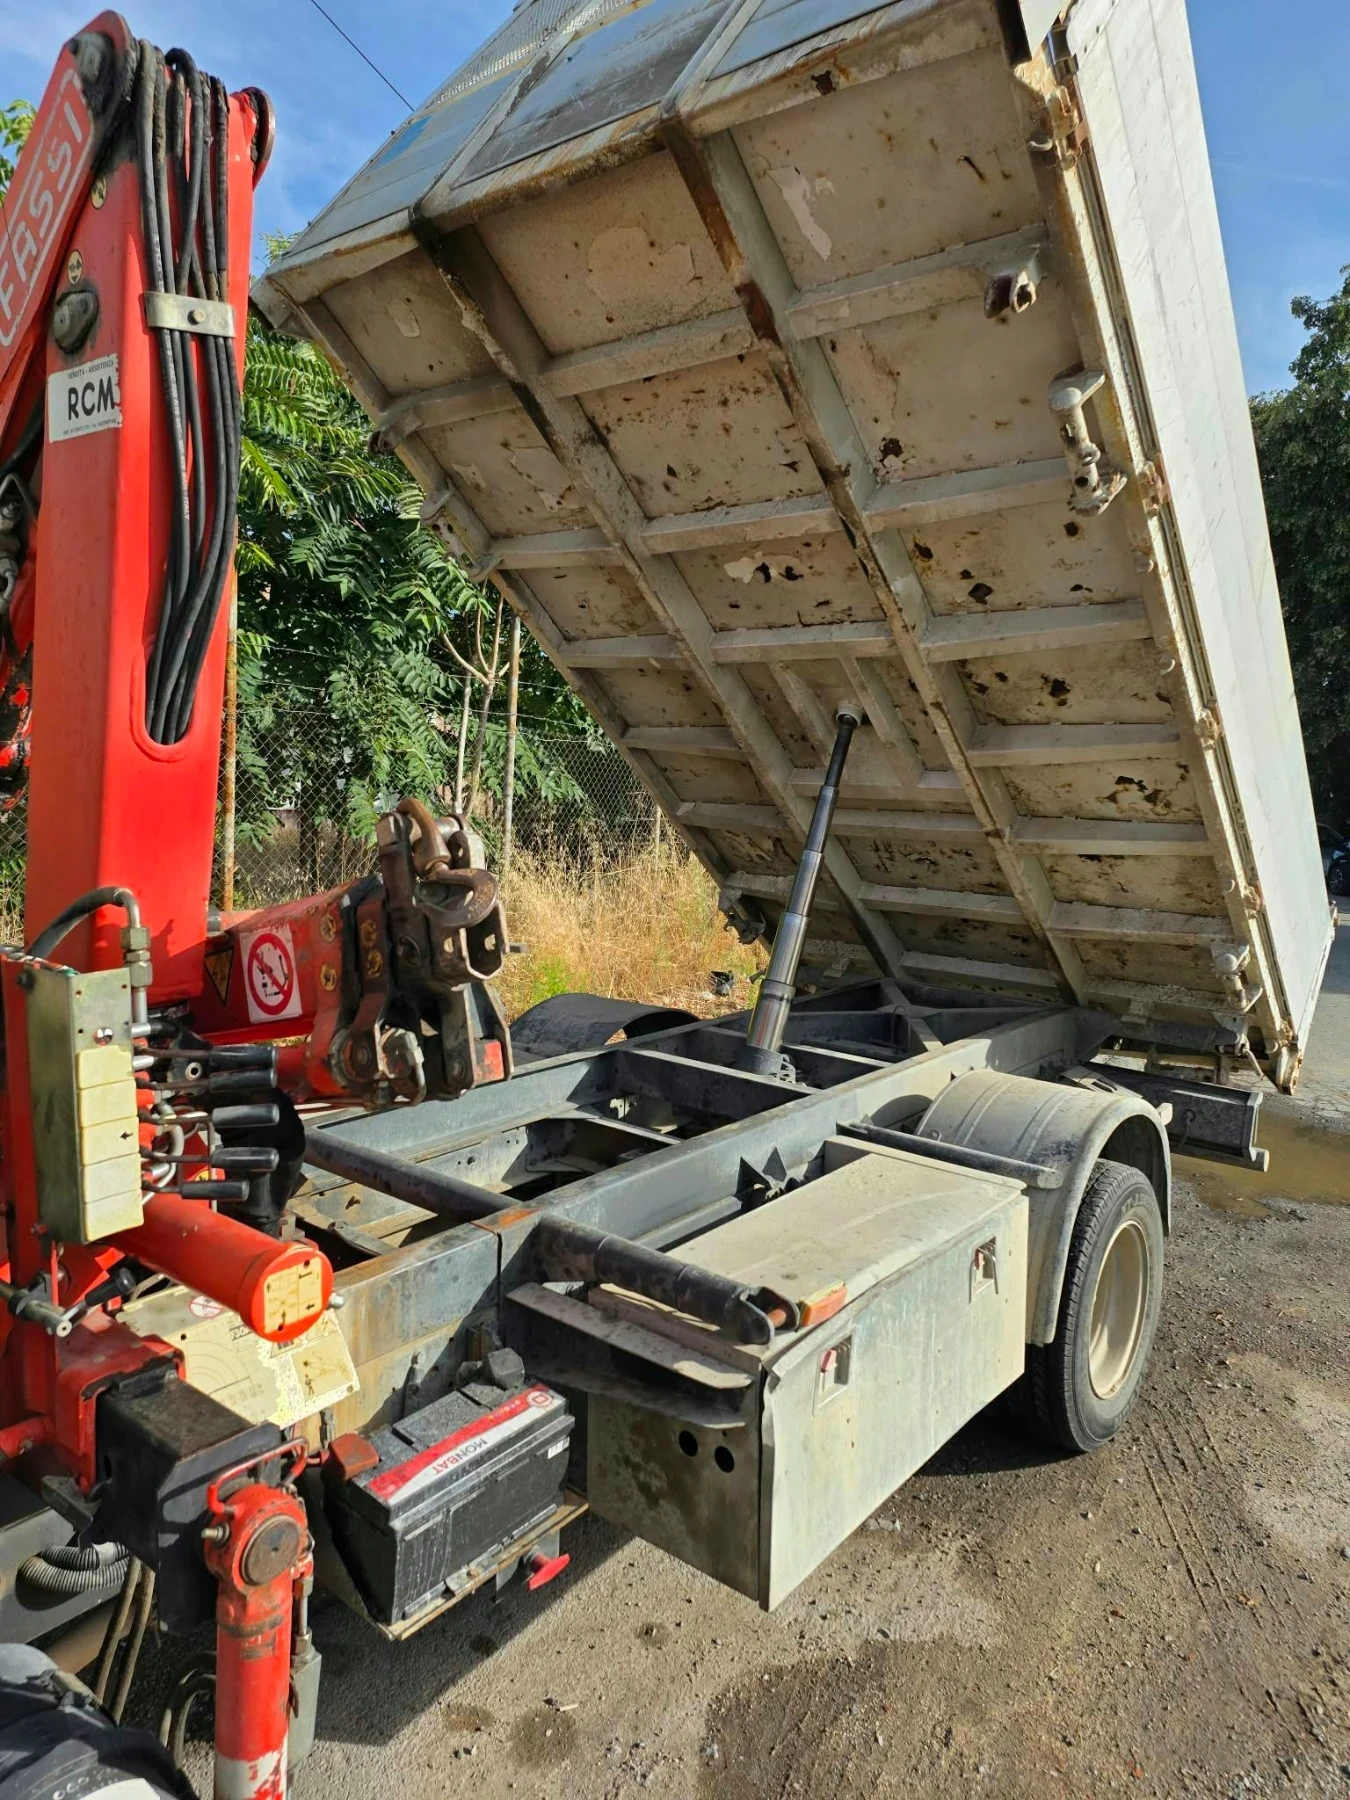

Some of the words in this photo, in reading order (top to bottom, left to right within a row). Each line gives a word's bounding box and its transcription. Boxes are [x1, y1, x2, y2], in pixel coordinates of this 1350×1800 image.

[0, 101, 82, 320] FASSI
[68, 375, 115, 421] RCM
[432, 1438, 488, 1475] MONBAT
